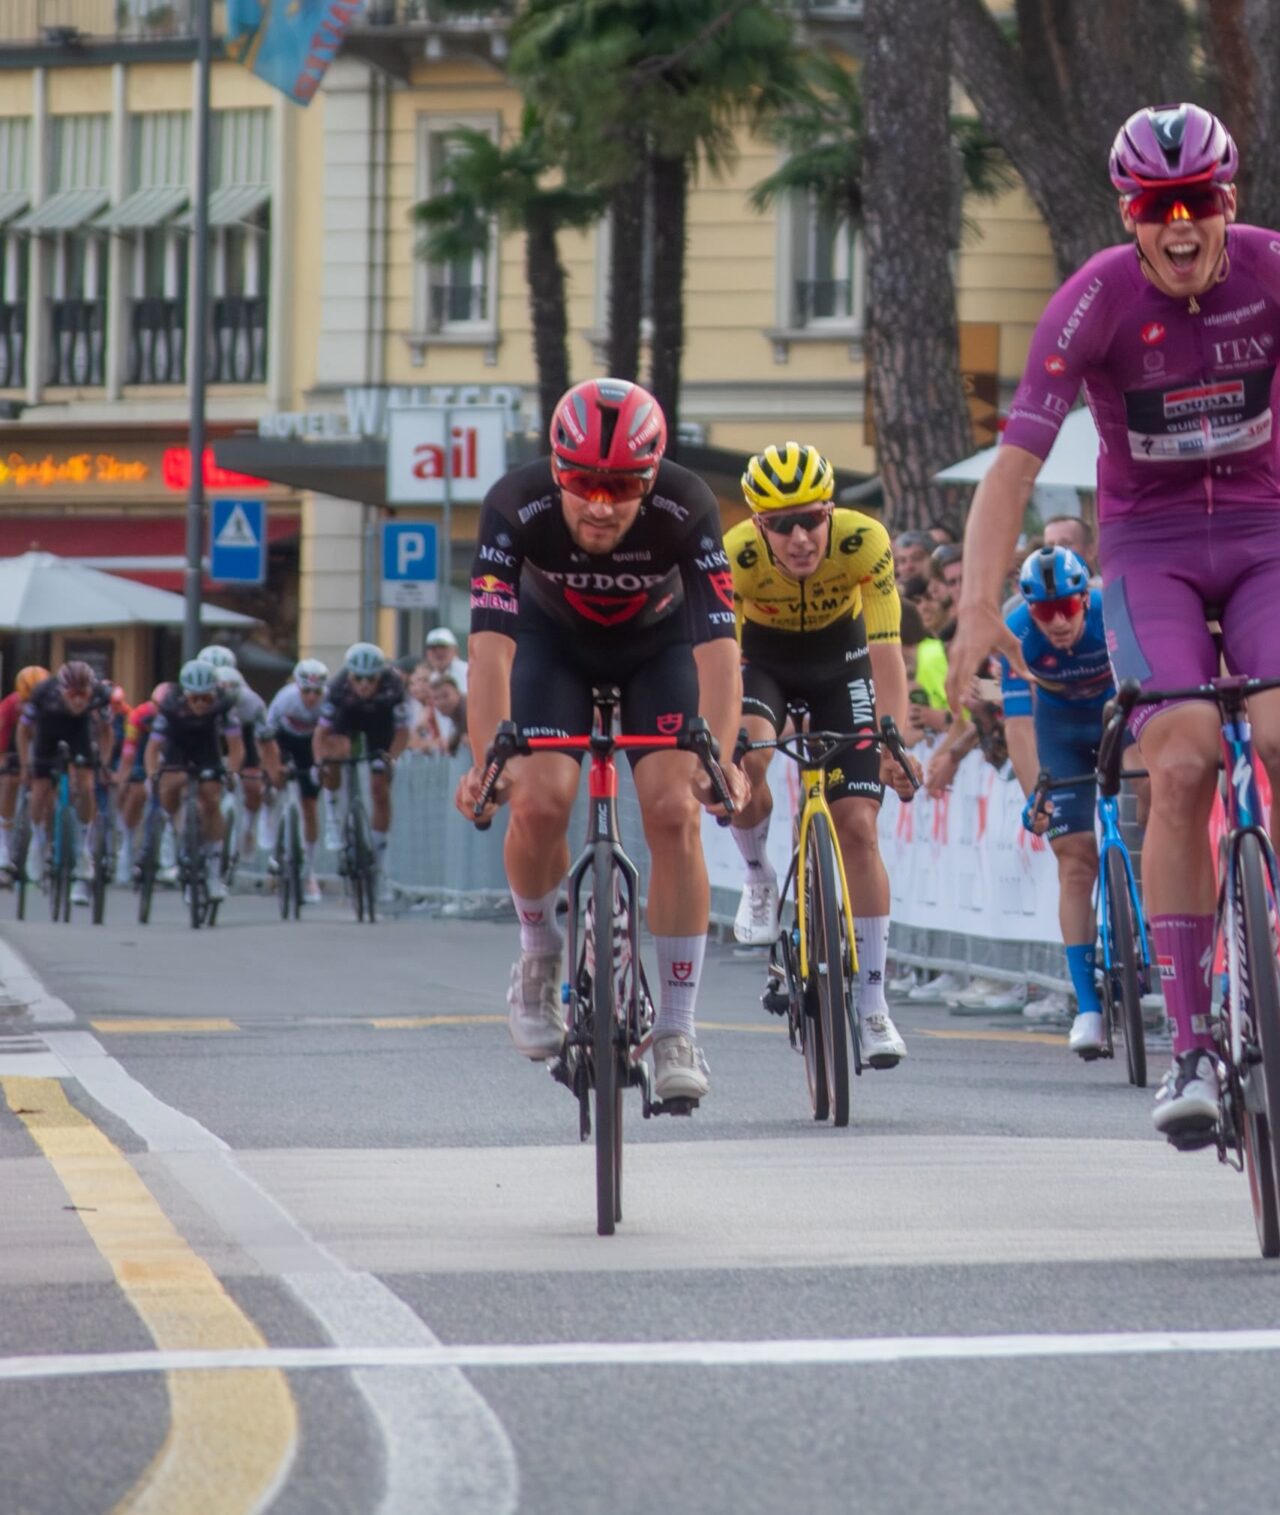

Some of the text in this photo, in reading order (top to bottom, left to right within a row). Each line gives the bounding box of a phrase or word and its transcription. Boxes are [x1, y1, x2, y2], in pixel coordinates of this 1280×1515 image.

[1057, 276, 1104, 350] CASTELLI
[1212, 336, 1266, 364] ITA
[412, 427, 477, 480] ail
[518, 495, 552, 524] BMC
[653, 494, 689, 522] BMC
[397, 532, 425, 575] P
[480, 544, 517, 567] MSC
[695, 549, 729, 571] MSC
[541, 570, 665, 591] TUDOR
[847, 678, 873, 724] VISMA
[598, 803, 608, 834] BMC
